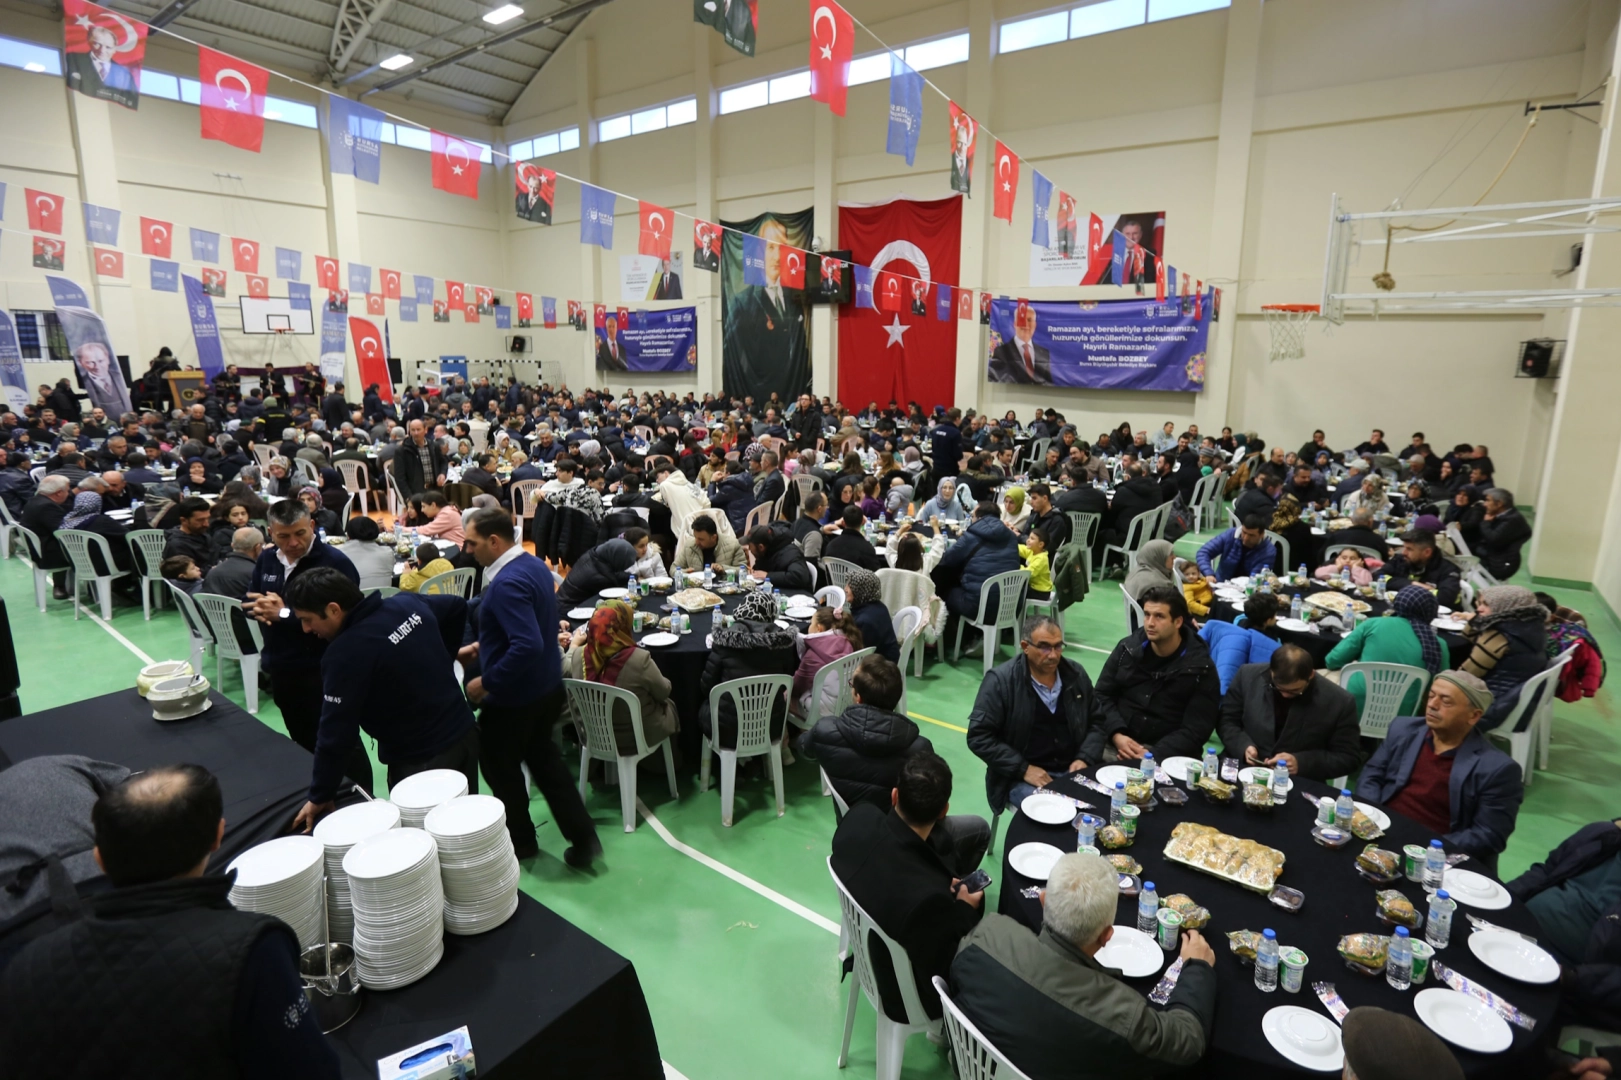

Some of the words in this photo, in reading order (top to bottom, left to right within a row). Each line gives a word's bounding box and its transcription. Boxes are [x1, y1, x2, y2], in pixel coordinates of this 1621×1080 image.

[1097, 325, 1141, 334] bereketiyle
[1142, 325, 1198, 333] sofralarımıza,
[1052, 334, 1088, 342] huzuruyla
[388, 611, 422, 645] BURFAŞ
